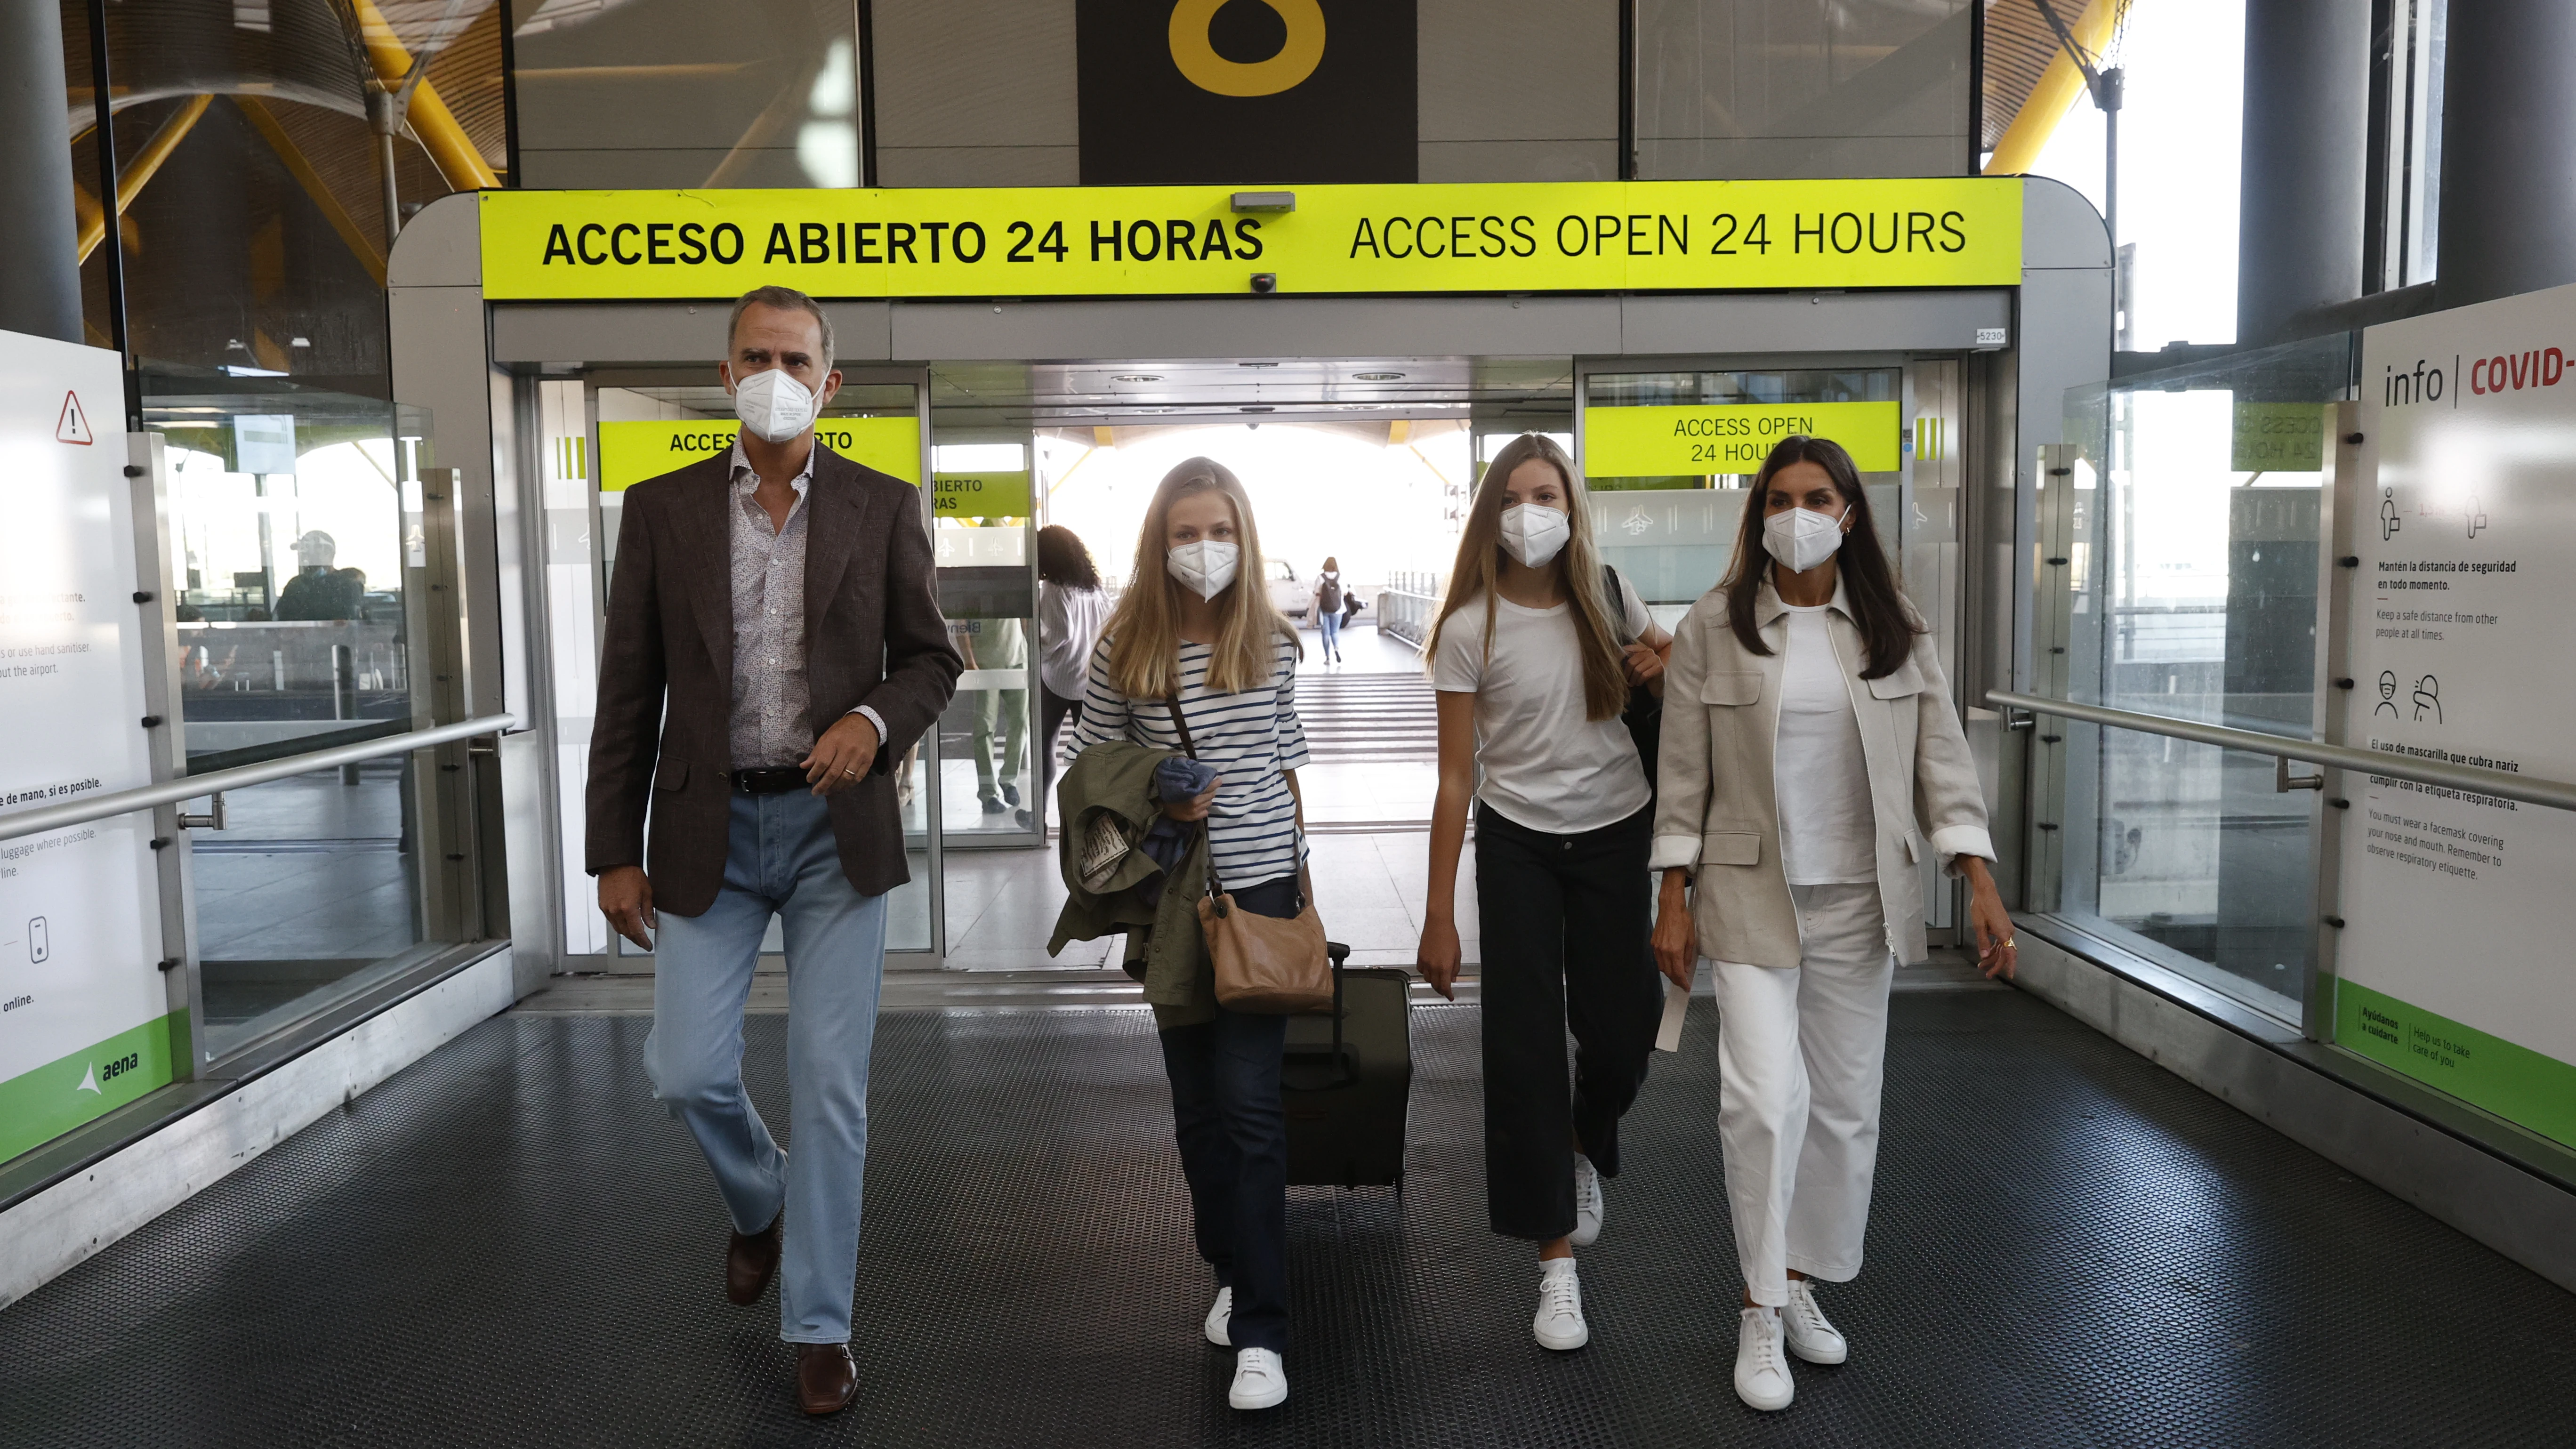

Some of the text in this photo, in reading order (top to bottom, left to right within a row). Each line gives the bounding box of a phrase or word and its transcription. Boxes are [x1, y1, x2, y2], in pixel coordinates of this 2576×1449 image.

[543, 218, 1263, 265] ACCESO ABIERTO 24 HORAS
[1350, 211, 1965, 258] ACCESS OPEN 24 HOURS
[1980, 332, 2002, 340] 5230
[2386, 359, 2443, 407] info
[1674, 417, 1812, 436] ACCESS OPEN
[1691, 443, 1776, 461] 24 HOU
[2379, 561, 2516, 575] Mantén la distancia de seguridad
[2378, 579, 2450, 590] en todo momento.
[2376, 609, 2498, 625] Keep a safe distance from other
[2376, 628, 2445, 641] people at all times.
[8, 648, 16, 658] or
[19, 647, 33, 657] use
[35, 644, 55, 656] hand
[57, 642, 92, 654] sanitiser.
[14, 665, 27, 676] the
[30, 663, 58, 676] airport.
[2372, 739, 2519, 773] El uso de mascarilla que cubra nariz
[7, 793, 17, 805] de
[20, 789, 47, 803] mano,
[49, 784, 56, 797] si
[58, 784, 68, 795] es
[70, 778, 102, 795] posible.
[2370, 775, 2518, 812] cumplir con la etiqueta respiratoria.
[2368, 808, 2504, 851] You must wear a facemask covering
[1, 829, 97, 860] luggage where possible.
[2367, 827, 2502, 867] your nose and mouth. Remember to
[2367, 843, 2478, 880] observe respiratory etiquette.
[3, 994, 34, 1013] online.
[2362, 1006, 2399, 1030] Ayúdanos
[2362, 1022, 2399, 1045] a cuidarte
[2414, 1026, 2471, 1059] Help us to take
[103, 1052, 138, 1082] aena
[2413, 1044, 2455, 1068] care of you
